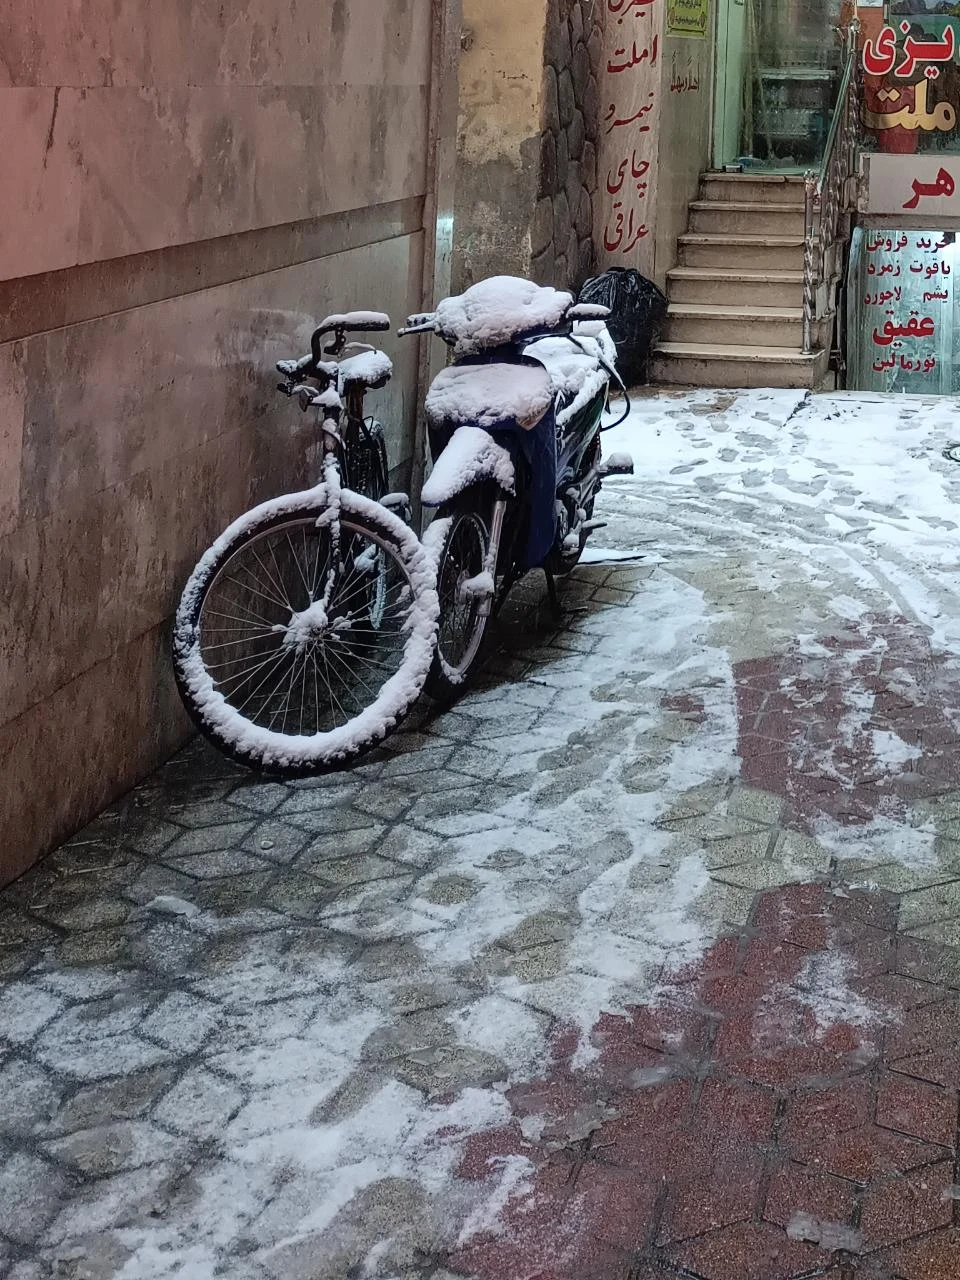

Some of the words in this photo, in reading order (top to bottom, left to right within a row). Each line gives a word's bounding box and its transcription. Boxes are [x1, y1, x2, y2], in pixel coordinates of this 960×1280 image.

[607, 34, 659, 73] املت
[604, 92, 654, 135] نیمرو
[606, 150, 650, 198] چای
[866, 231, 908, 252] فروش
[916, 234, 951, 253] خرید
[866, 260, 901, 276] زمرد
[909, 258, 951, 279] یاقوت
[864, 286, 902, 305] لاجورد
[923, 285, 949, 303] یشم
[872, 310, 935, 347] عقیق
[872, 351, 937, 372] تورمالین
